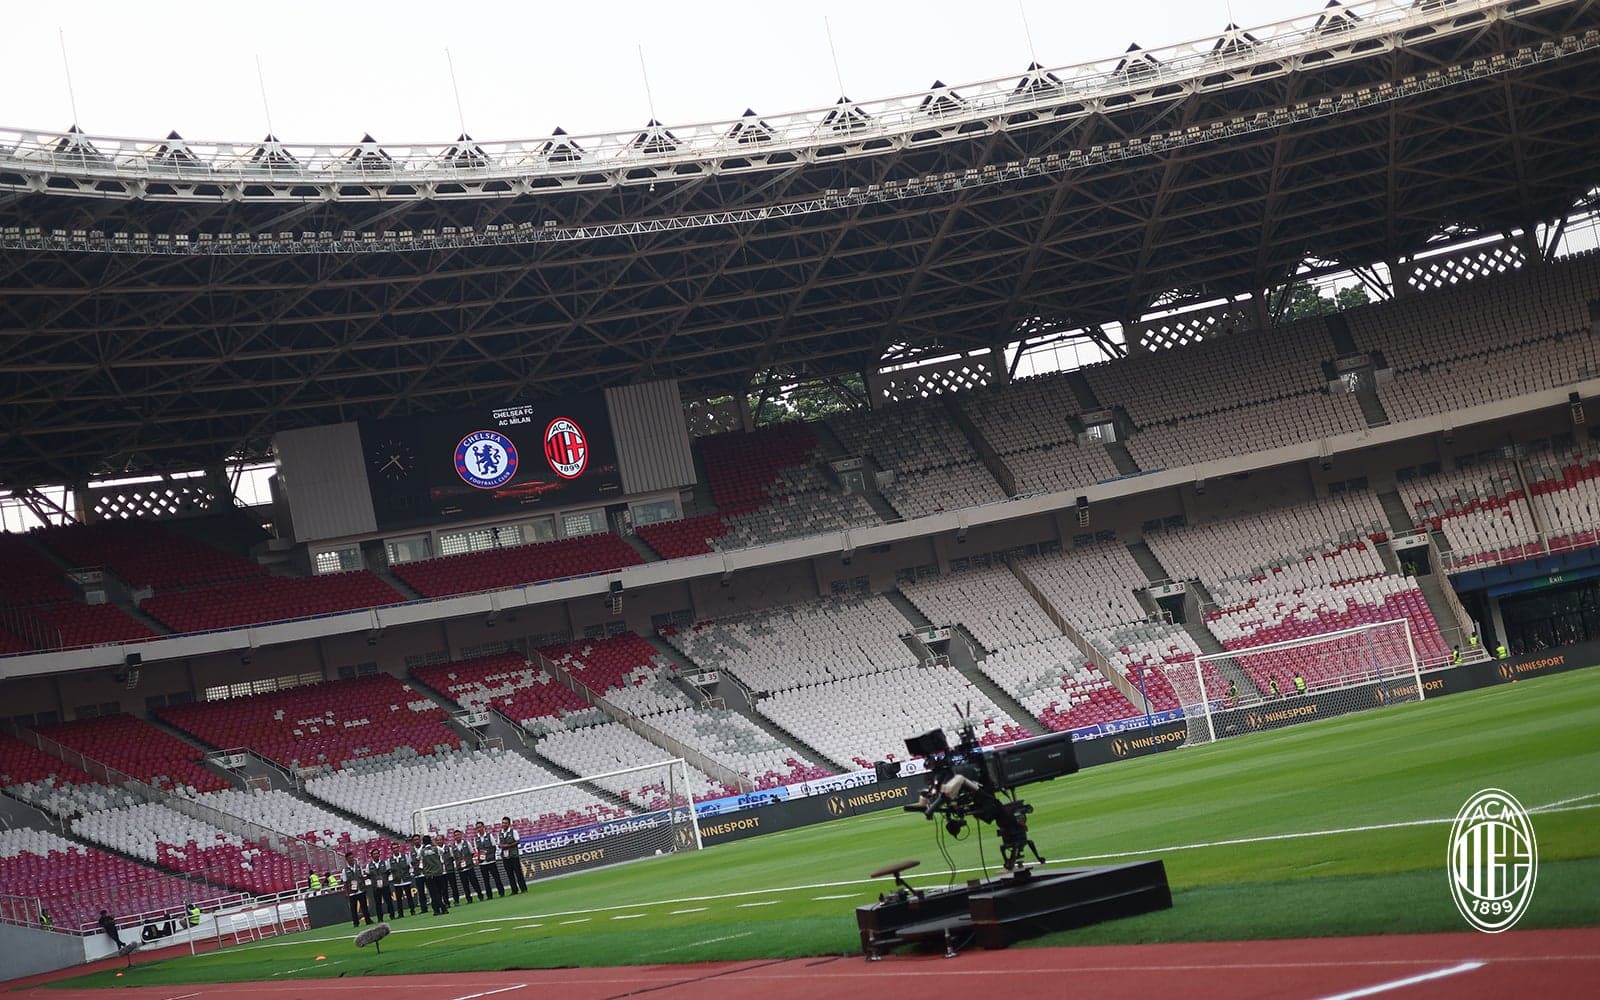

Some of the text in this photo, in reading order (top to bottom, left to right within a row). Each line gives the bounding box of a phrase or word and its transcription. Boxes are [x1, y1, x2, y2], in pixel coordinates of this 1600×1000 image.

[493, 410, 523, 419] CHELSEA
[510, 416, 531, 425] MILAN
[551, 422, 575, 435] ACM
[463, 432, 501, 447] CHELSEA
[560, 463, 580, 473] 1899
[469, 471, 511, 487] FOOTBALL CLUB
[1416, 535, 1426, 543] 32
[1174, 583, 1184, 592] 33
[940, 629, 949, 638] 34
[1515, 655, 1565, 673] NINESPORT
[708, 672, 717, 681] 35
[1392, 679, 1444, 697] NINESORT
[479, 713, 488, 721] 36
[1264, 704, 1318, 722] NINESPORT
[235, 755, 244, 764] 37
[848, 786, 908, 807] NINESPORT
[699, 816, 760, 838] NINESPORT
[523, 834, 570, 853] CHELSEA
[574, 831, 587, 844] FC
[540, 849, 605, 871] NINESPORT
